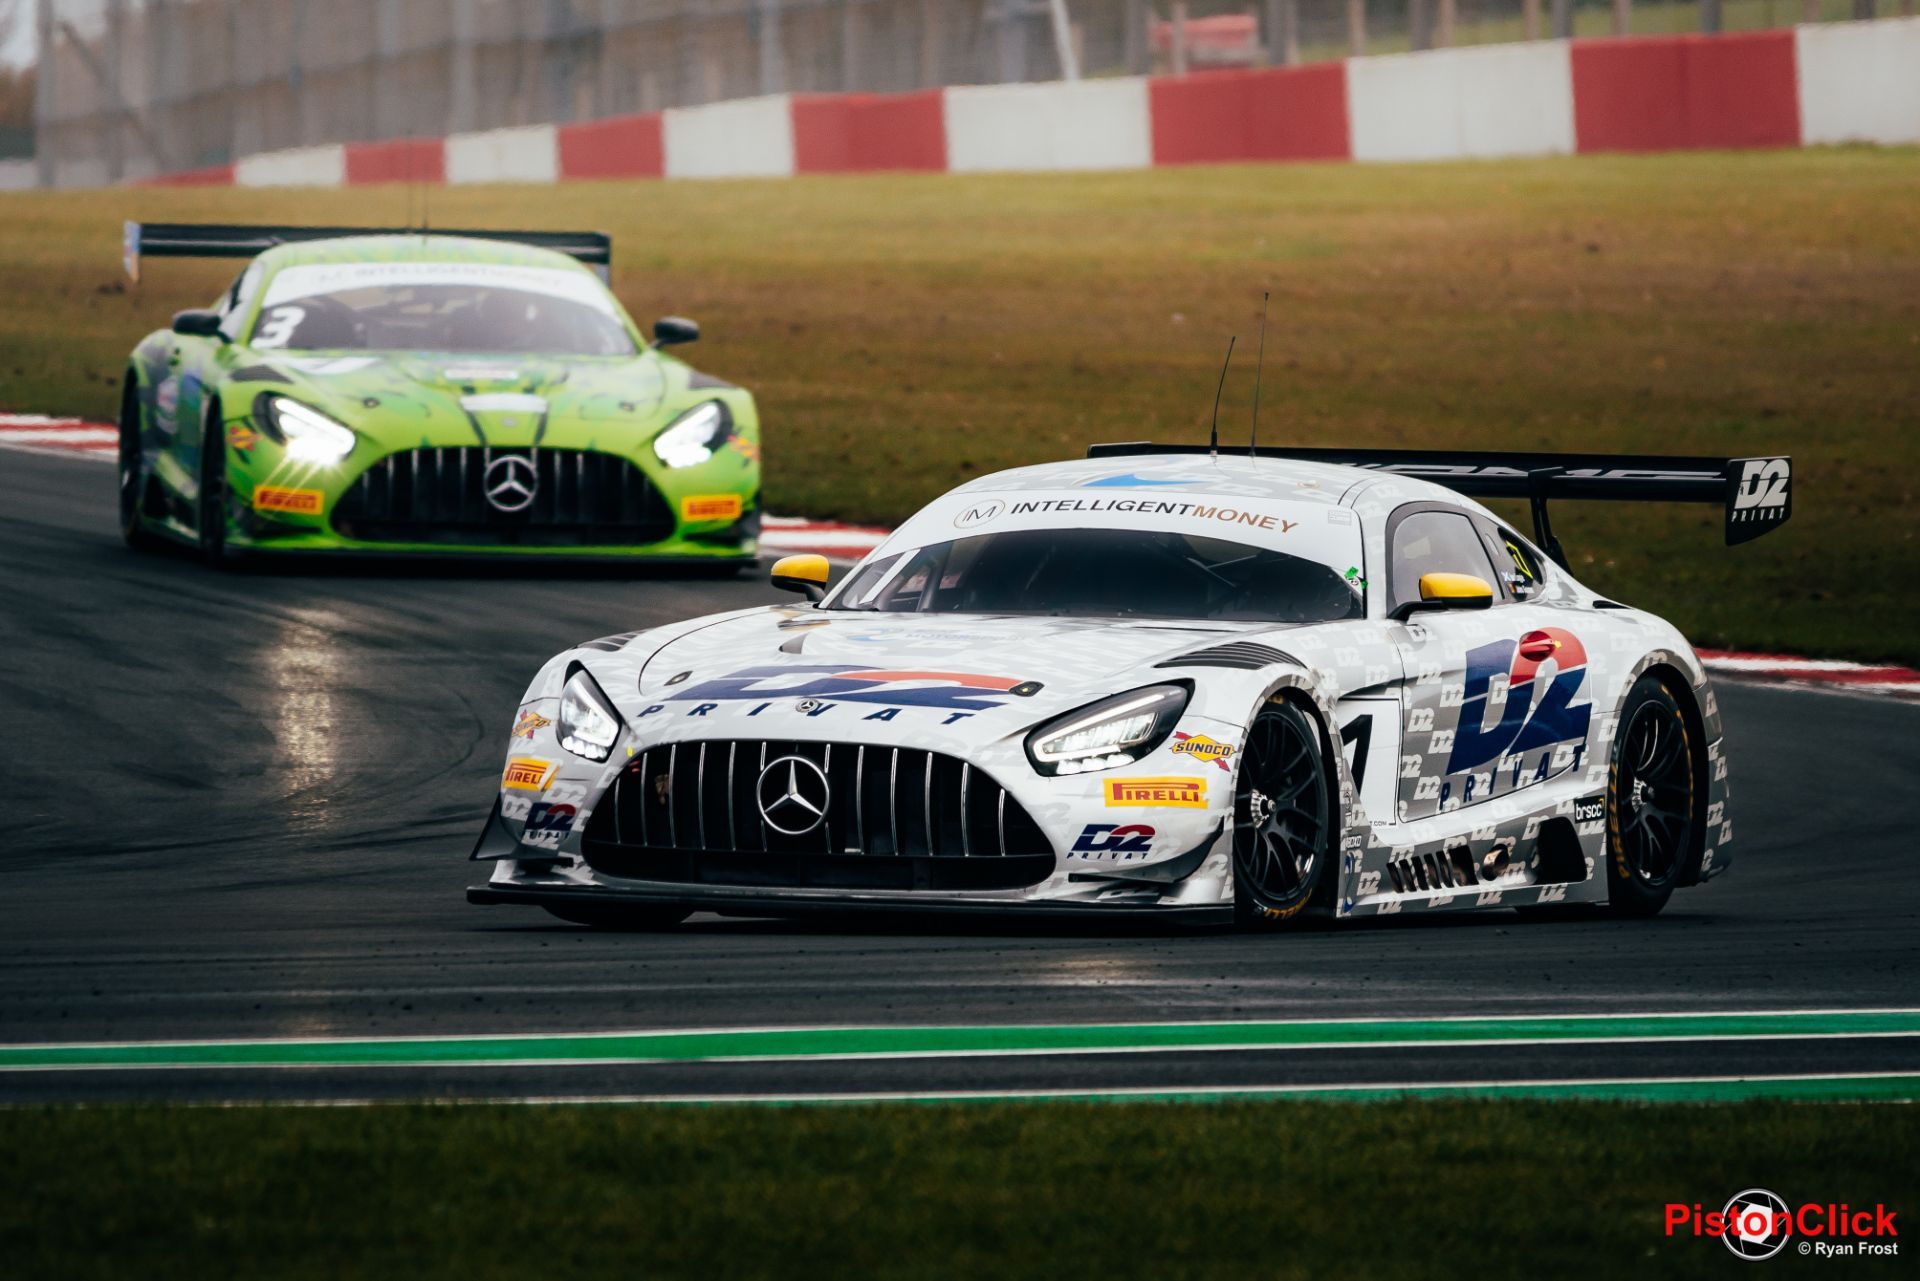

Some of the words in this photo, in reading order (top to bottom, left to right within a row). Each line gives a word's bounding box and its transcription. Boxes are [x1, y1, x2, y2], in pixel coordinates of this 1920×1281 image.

[252, 305, 306, 349] 3
[1732, 458, 1791, 509] D2
[1010, 499, 1299, 533] INTELLIGENTMONEY
[1730, 506, 1787, 523] PRIVAT
[637, 702, 977, 725] PRIVAT
[1445, 626, 1592, 776] D2
[1408, 707, 1435, 732] D2
[1175, 741, 1232, 757] SUNOCO
[1428, 729, 1455, 754] D2
[1414, 775, 1442, 800] D2
[1439, 744, 1588, 812] PRIVAT
[1112, 783, 1200, 802] PIRELLI
[523, 802, 578, 832] D2
[1574, 802, 1604, 820] brscc
[1071, 823, 1156, 852] D2
[1066, 851, 1150, 861] PRIVAT
[1357, 870, 1382, 896] D2
